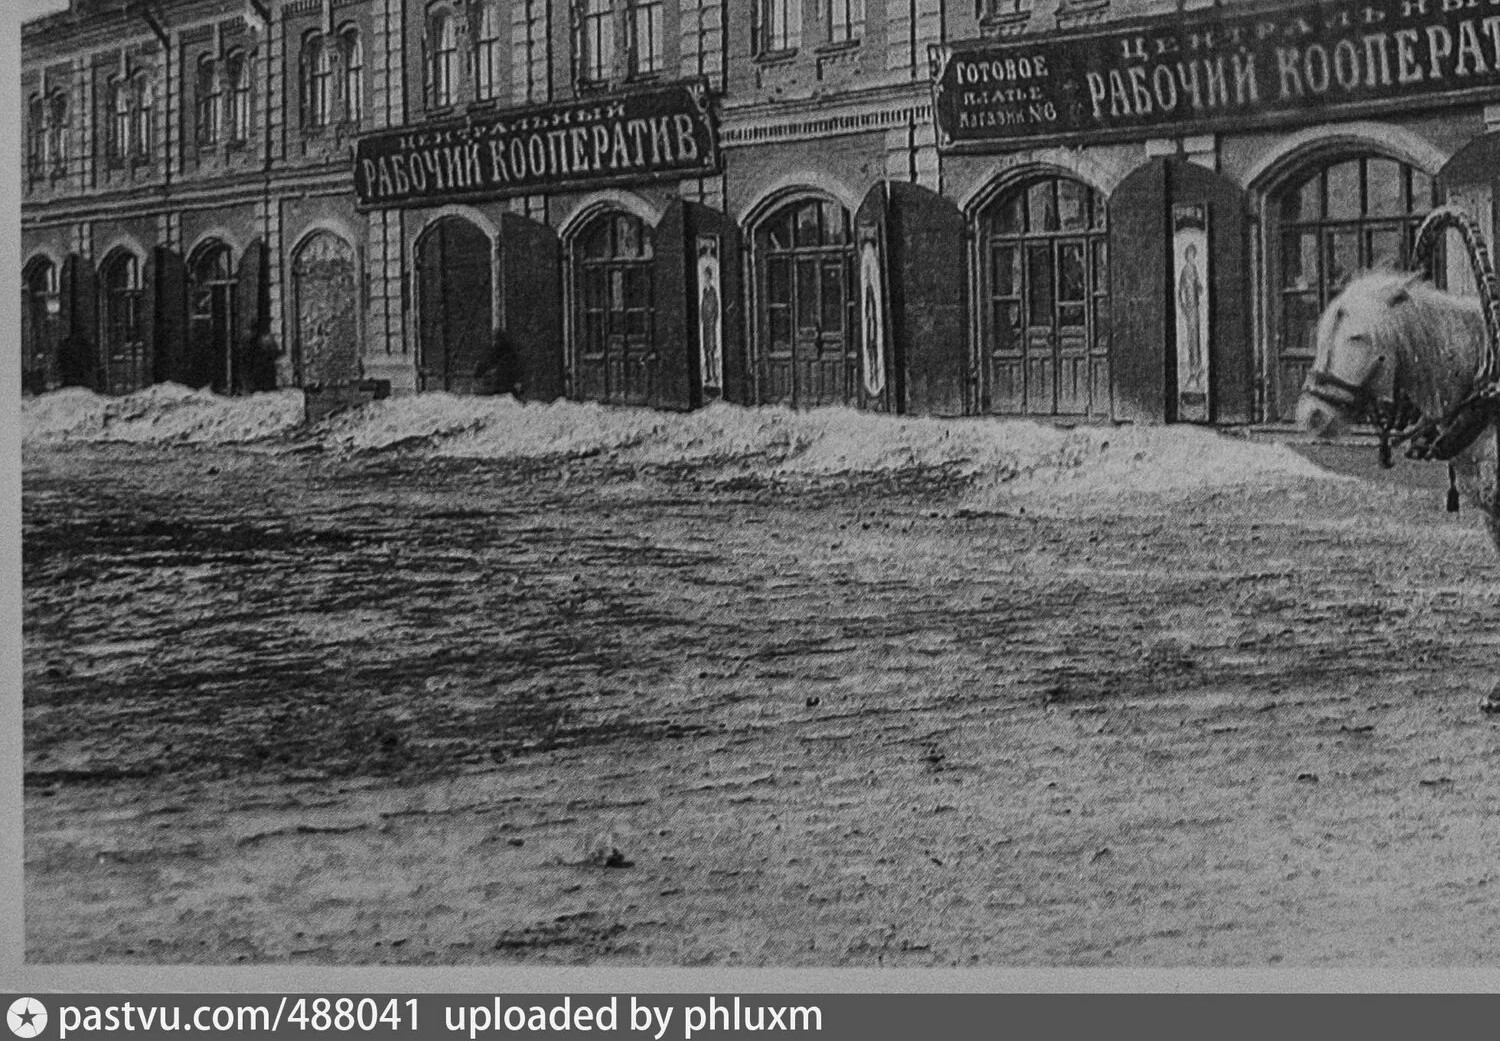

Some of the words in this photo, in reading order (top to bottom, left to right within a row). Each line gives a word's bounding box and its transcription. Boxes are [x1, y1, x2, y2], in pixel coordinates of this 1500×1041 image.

[956, 56, 1050, 85] ГОТОВОЕ
[1086, 46, 1259, 119] РАБОЧИЙ
[963, 85, 1044, 106] ПЛАТЬЕ
[400, 101, 625, 150] ЦЕНТРАЛЬНЫЙ
[363, 140, 483, 197] РАБОЧИЙ
[488, 114, 698, 183] КООПЕРАТИВ
